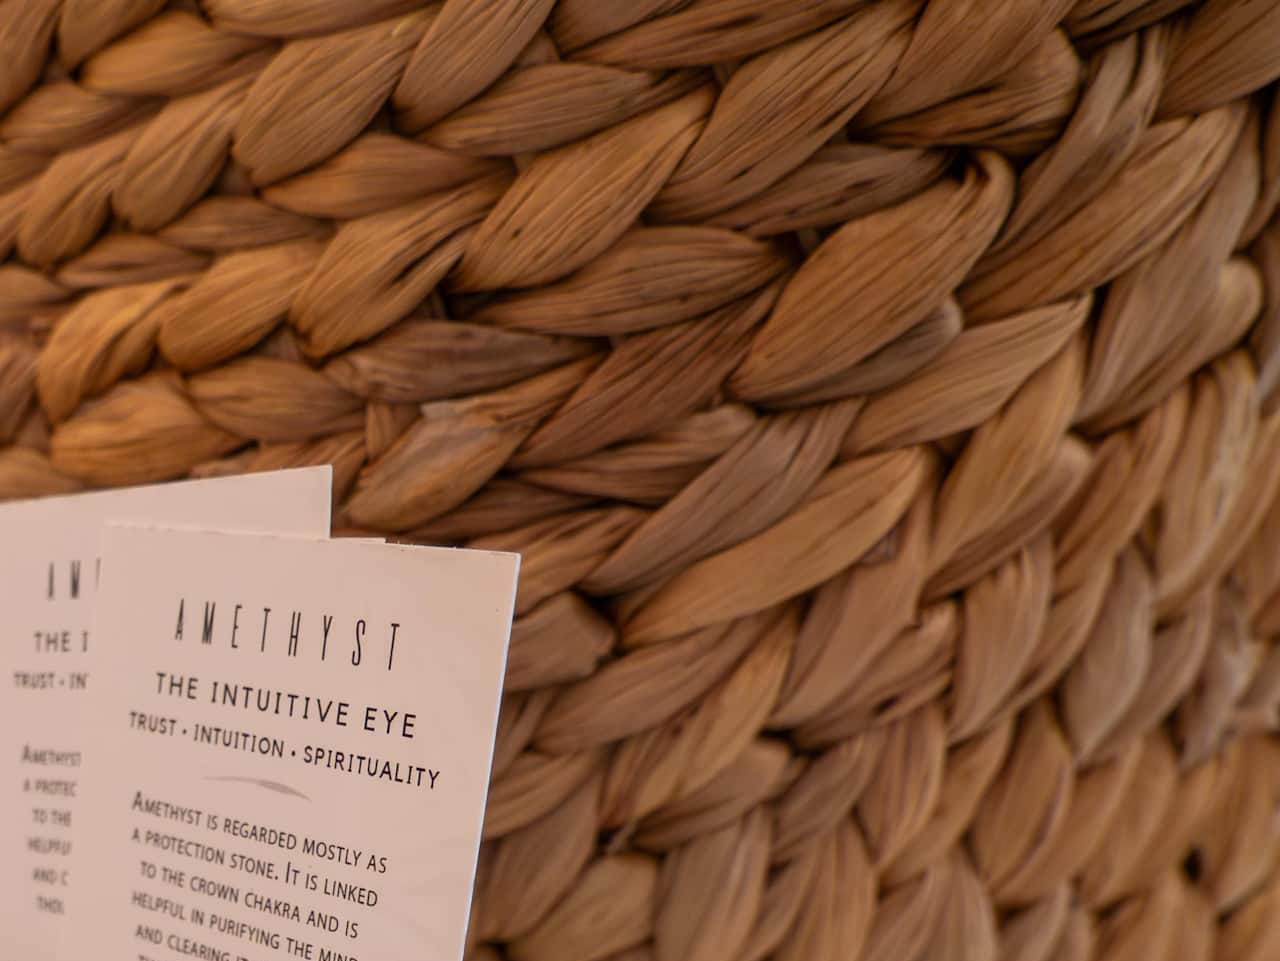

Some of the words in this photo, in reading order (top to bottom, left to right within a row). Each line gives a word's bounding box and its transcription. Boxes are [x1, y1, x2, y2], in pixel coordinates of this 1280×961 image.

[32, 630, 71, 654] THE
[174, 598, 400, 671] AMETHYST
[156, 672, 198, 699] THE
[211, 681, 349, 726] INTUITIVE
[364, 707, 416, 738] EYE
[129, 711, 177, 735] TRUST
[193, 723, 284, 758] INTUITION
[303, 745, 440, 789] SPIRITUALITY
[132, 791, 202, 826] AMETHYST
[207, 814, 218, 830] IS
[223, 818, 297, 850] REGARDED
[302, 837, 362, 866] MOSTLY
[366, 854, 387, 874] AS
[132, 828, 141, 843] A
[145, 830, 225, 865] PROTECTION
[230, 853, 279, 880] STONE.
[286, 862, 300, 885] IT
[305, 873, 318, 891] IS
[324, 878, 378, 907] LINKED
[132, 890, 185, 921] HELPFUL
[191, 908, 204, 926] IN
[209, 913, 279, 949] PURIFYING
[286, 937, 313, 960] THE
[135, 924, 162, 945] AND
[140, 861, 157, 879] TO
[161, 867, 185, 888] THE
[189, 876, 239, 904] CROWN
[245, 892, 300, 922] CHAKRA
[306, 910, 339, 933] AND
[345, 920, 358, 938] IS
